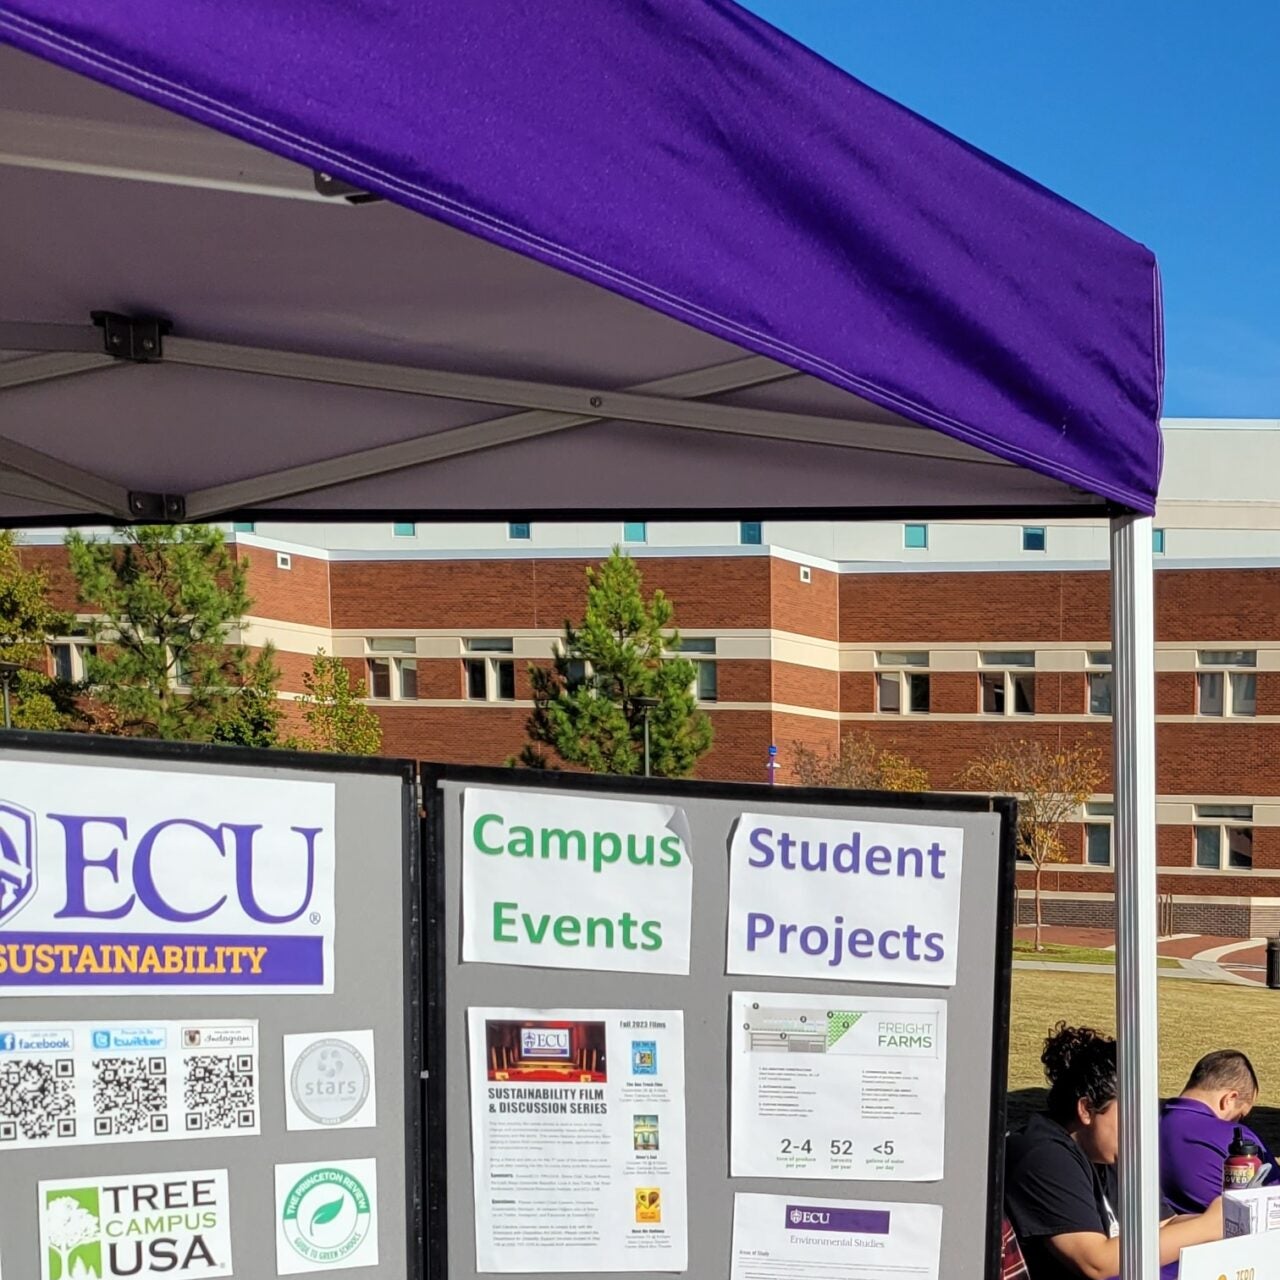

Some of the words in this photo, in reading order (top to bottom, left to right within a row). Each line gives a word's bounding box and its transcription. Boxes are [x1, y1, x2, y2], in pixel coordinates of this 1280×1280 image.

[473, 814, 682, 873] Campus
[748, 827, 947, 879] Student
[46, 813, 323, 924] ECU
[492, 900, 663, 951] Events
[746, 912, 945, 966] Projects
[878, 1022, 932, 1034] FREIGHT
[19, 1037, 70, 1049] facebook
[114, 1036, 163, 1048] twitter
[537, 1033, 567, 1047] ECU
[878, 1035, 932, 1048] FARMS
[305, 1079, 356, 1096] stars
[488, 1088, 576, 1100] SUSTAINABILITY
[579, 1089, 604, 1100] FILM
[489, 1103, 496, 1113] &
[499, 1102, 567, 1114] DISCUSSION
[570, 1103, 607, 1114] SERIES
[781, 1138, 812, 1154] 2-4
[830, 1140, 853, 1155] 52
[873, 1141, 894, 1155] <5
[103, 1180, 217, 1213] TREE
[286, 1193, 299, 1216] THE
[295, 1172, 344, 1197] PRINCETON
[343, 1177, 367, 1209] REVIEW
[105, 1211, 217, 1238] CAMPUS
[802, 1212, 830, 1224] ECU
[790, 1235, 852, 1247] Environmental
[855, 1239, 885, 1248] Studies
[109, 1235, 217, 1276] USA
